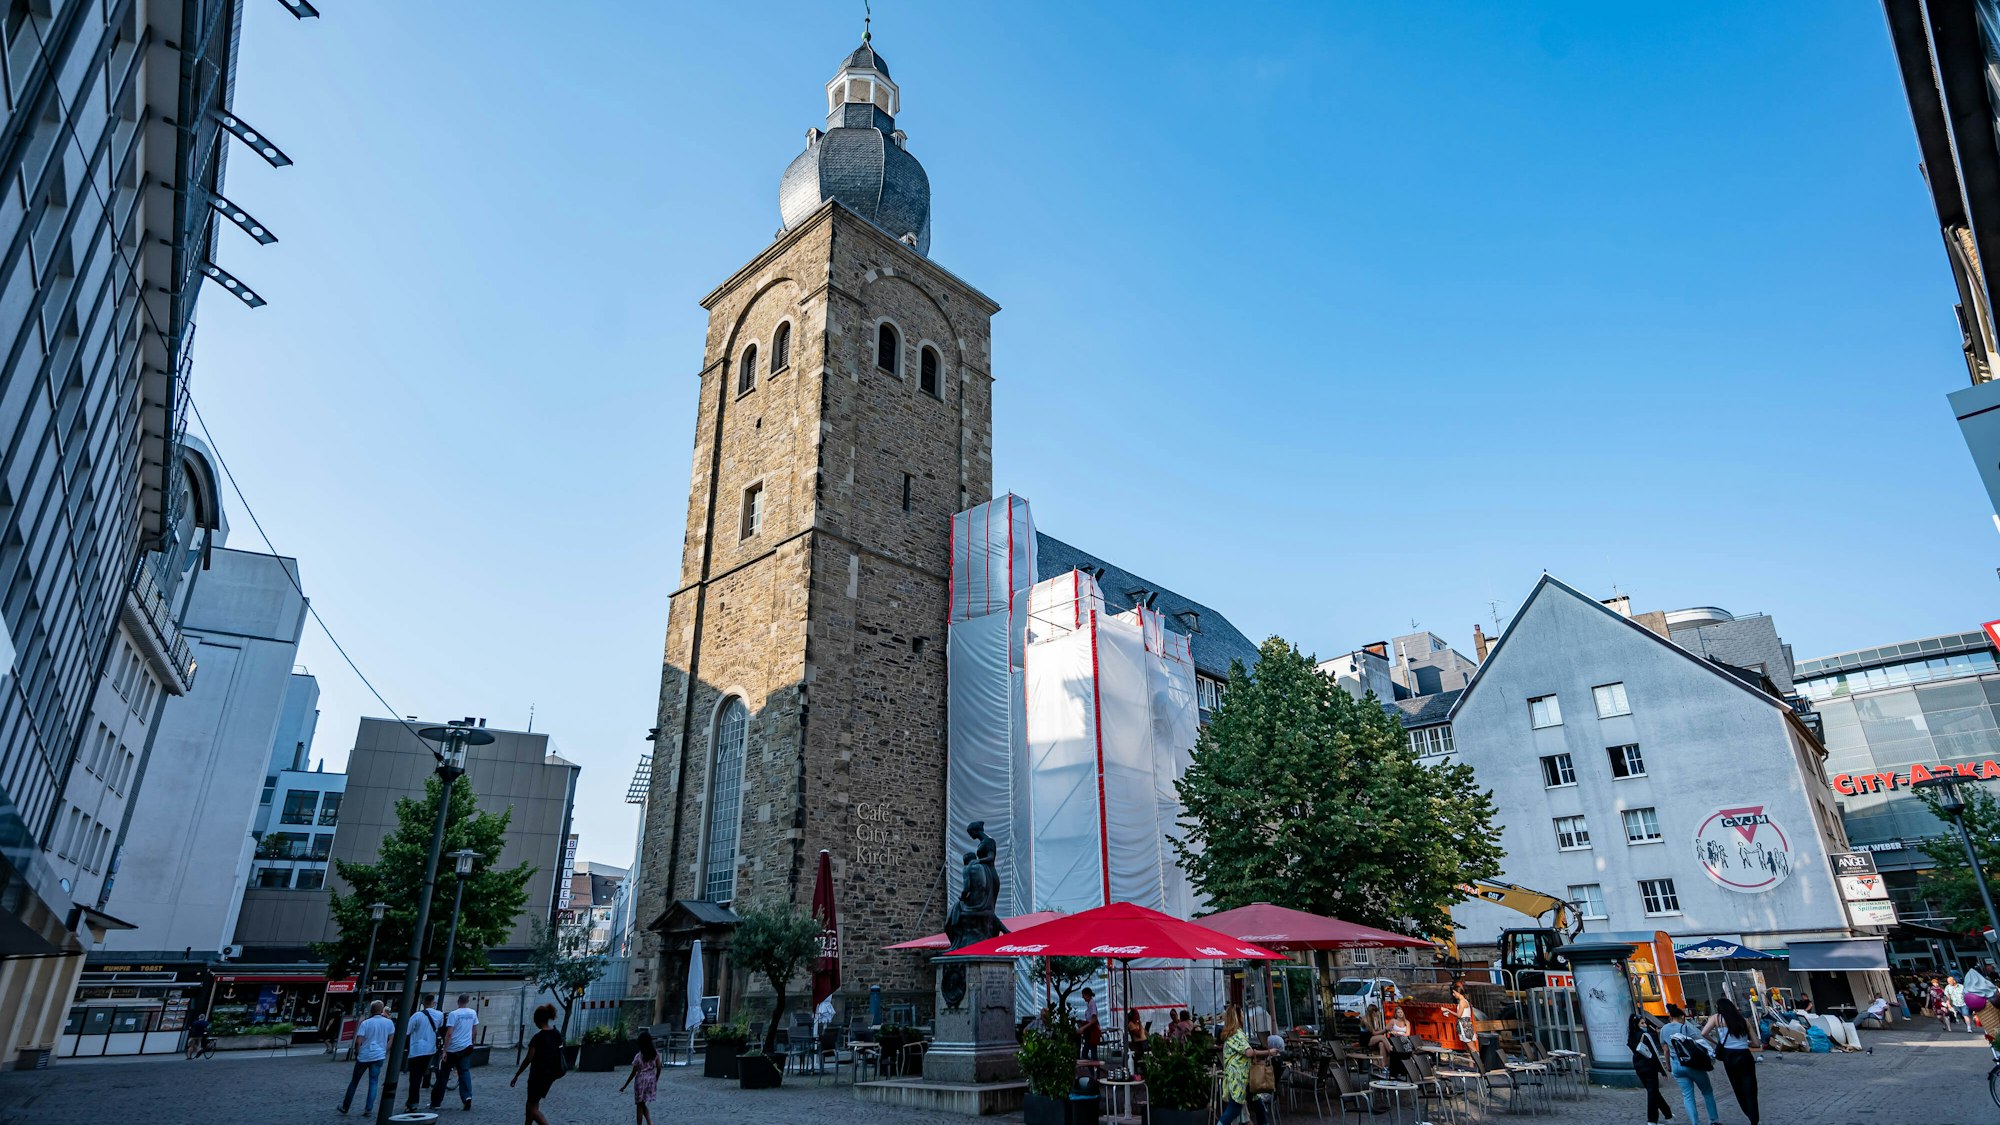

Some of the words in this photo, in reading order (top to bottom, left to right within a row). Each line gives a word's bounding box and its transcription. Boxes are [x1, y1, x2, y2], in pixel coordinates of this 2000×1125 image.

[857, 802, 890, 822] Café
[1723, 815, 1768, 827] CVJM
[856, 823, 890, 849] City
[1873, 842, 1902, 851] WEBER
[856, 845, 903, 867] Kirche
[1839, 857, 1869, 868] ANGEL
[560, 840, 575, 909] BRILLEN
[1487, 891, 1500, 900] CAT
